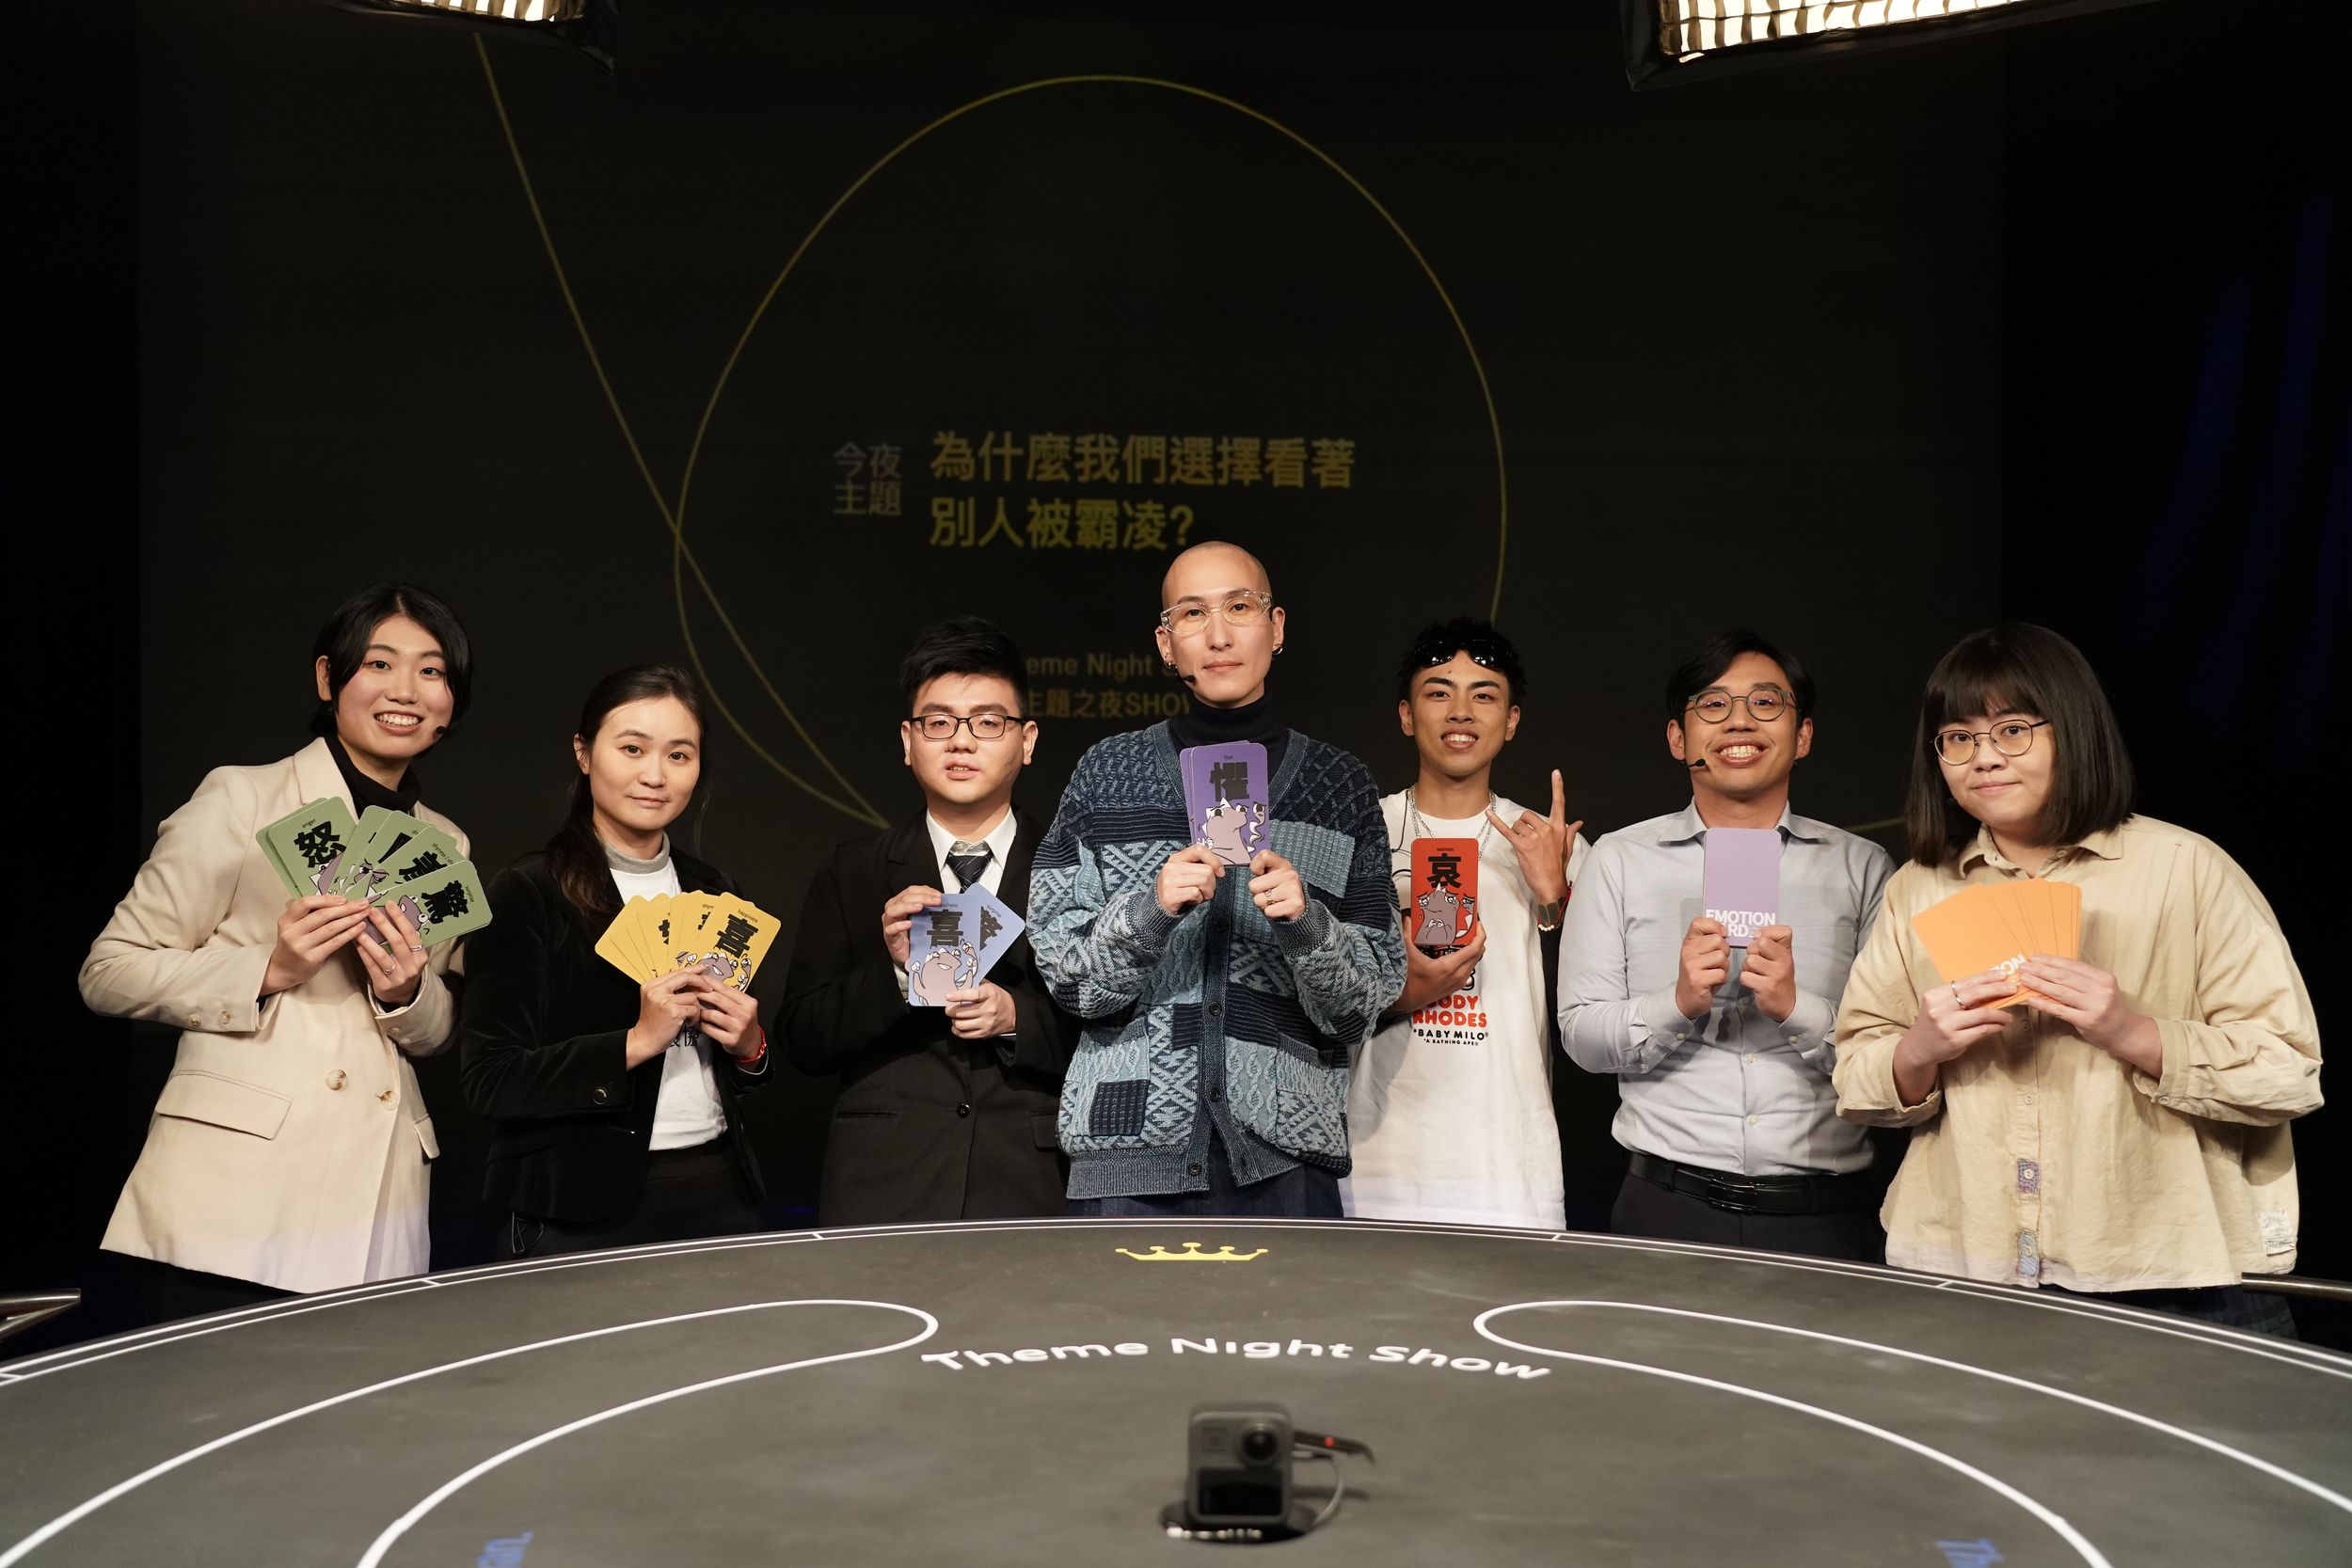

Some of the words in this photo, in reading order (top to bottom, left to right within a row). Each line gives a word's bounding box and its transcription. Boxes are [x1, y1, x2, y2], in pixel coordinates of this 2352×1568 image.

[834, 442, 901, 479] 今夜
[930, 431, 1355, 488] 為什麼我們選擇看著
[834, 480, 902, 515] 主題
[1025, 656, 1078, 676] eme
[1087, 651, 1153, 683] Night
[294, 820, 347, 868] 怒
[1426, 852, 1462, 889] 哀
[737, 909, 759, 924] happiness
[926, 909, 964, 947] 喜
[716, 913, 759, 958] 喜
[1412, 1009, 1487, 1028] RHODES
[1425, 995, 1479, 1010] ODY
[921, 1342, 1149, 1370] Theme
[1171, 1338, 1353, 1359] Night
[1369, 1346, 1550, 1380] Show
